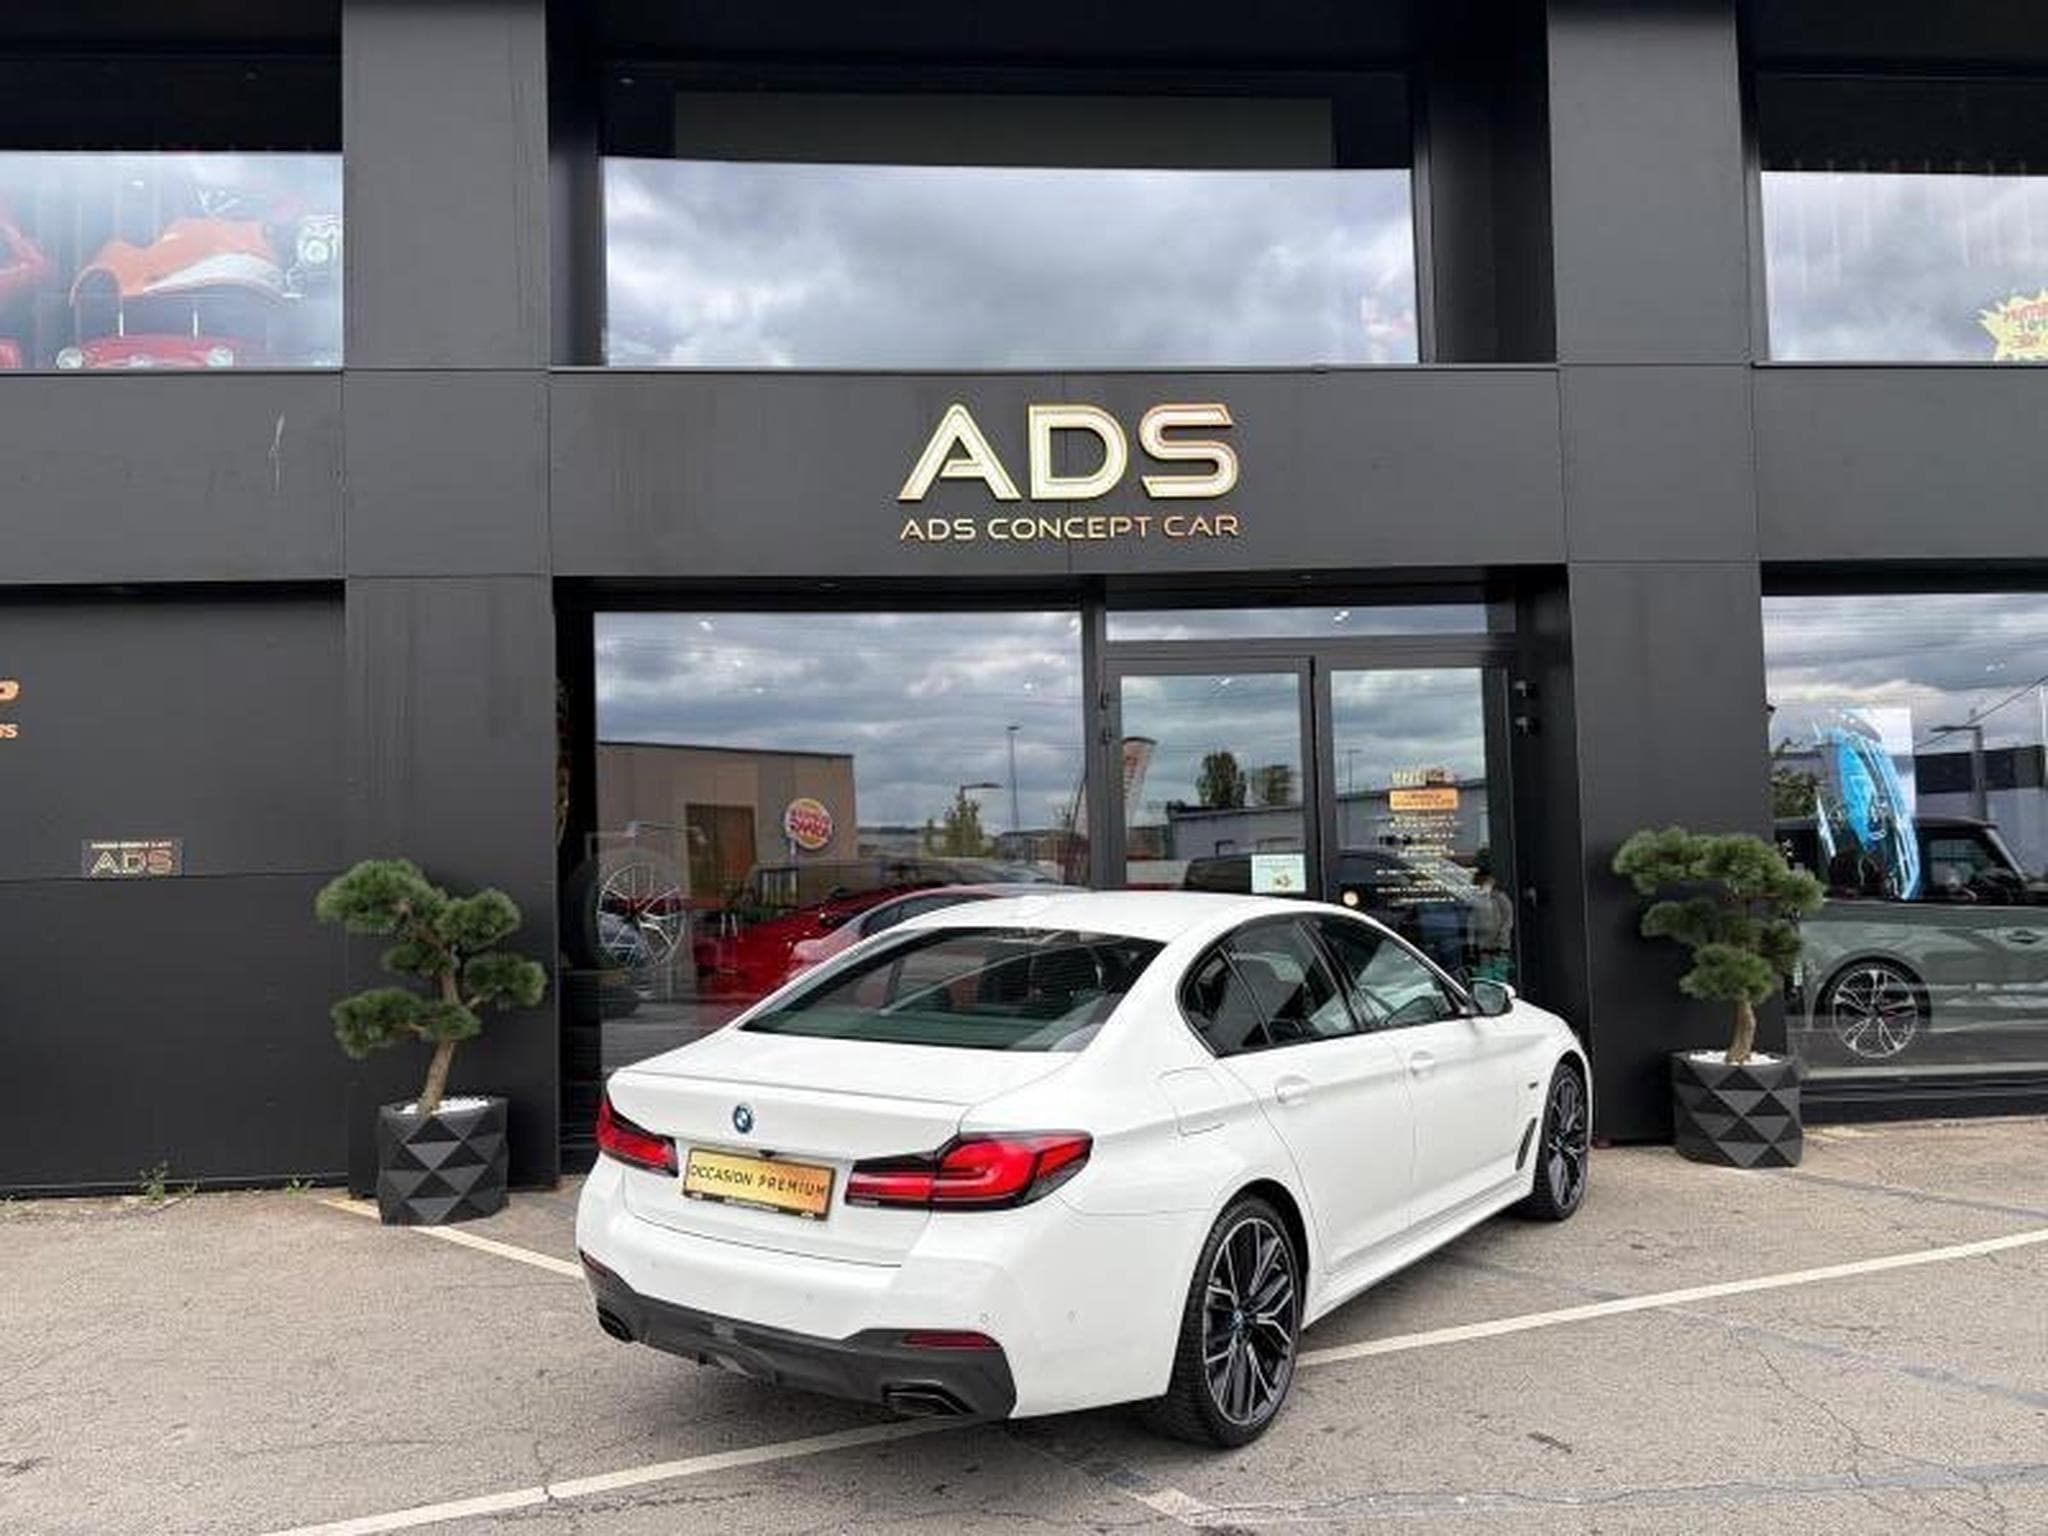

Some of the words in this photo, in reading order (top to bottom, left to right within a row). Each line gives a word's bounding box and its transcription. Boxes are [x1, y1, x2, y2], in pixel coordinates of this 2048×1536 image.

[897, 403, 1239, 500] ADS
[899, 517, 976, 541] ADS
[987, 516, 1152, 539] CONCEPT
[1163, 515, 1239, 537] CAR
[690, 1164, 753, 1187] OCCASION
[758, 1175, 828, 1198] PREMIUM
